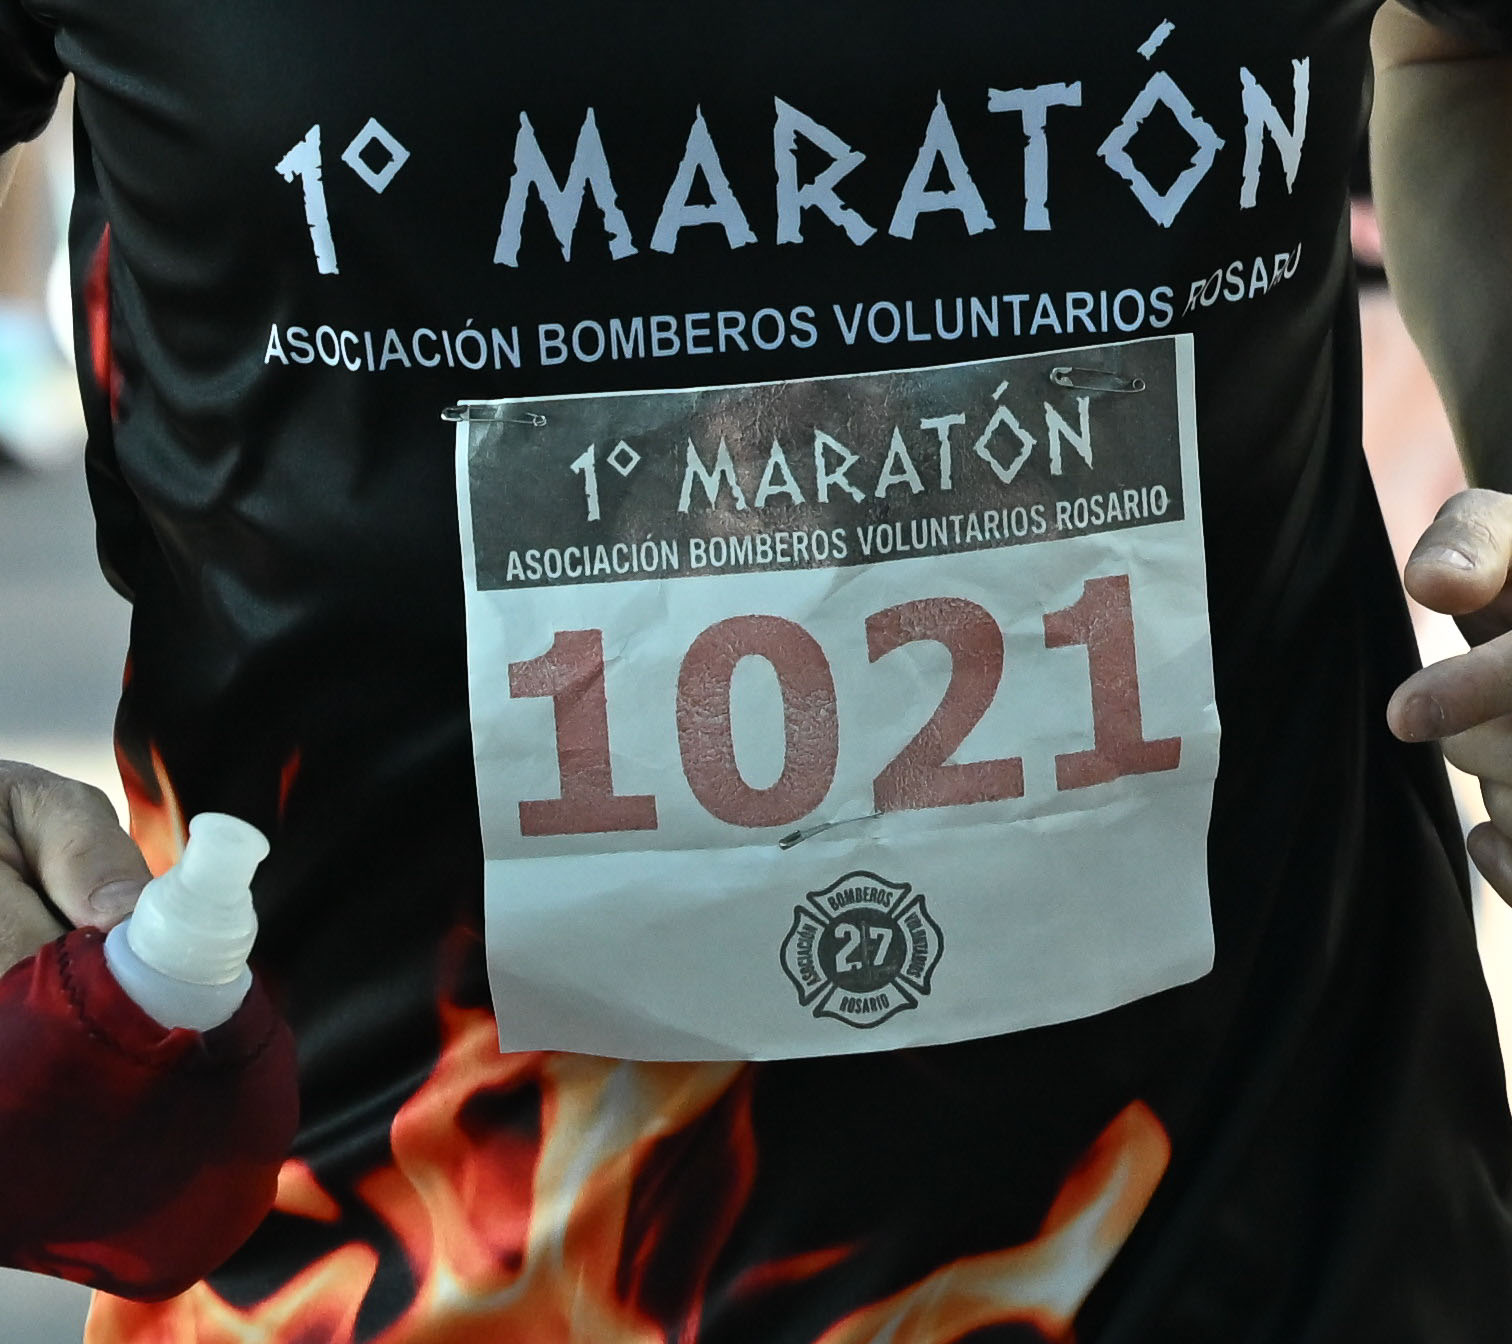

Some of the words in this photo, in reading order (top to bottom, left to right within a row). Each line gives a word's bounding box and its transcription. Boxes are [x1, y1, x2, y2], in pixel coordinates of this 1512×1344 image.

[493, 18, 1309, 267] MARATÓN
[263, 317, 521, 372] ASOCIACIÓN
[538, 306, 818, 366] BOMBEROS
[832, 285, 1175, 345] VOLUNTARIOS
[677, 380, 1094, 513] MARATÓN
[506, 534, 680, 582] ASOCIACIÓN
[689, 528, 848, 569] BOMBEROS
[857, 504, 1047, 556] VOLUNTARIOS
[1055, 484, 1168, 532] ROSARIO
[507, 573, 1182, 838] 1021
[827, 885, 893, 912] BOMBEROS
[834, 923, 893, 973] 27
[839, 993, 890, 1015] ROSARIO
